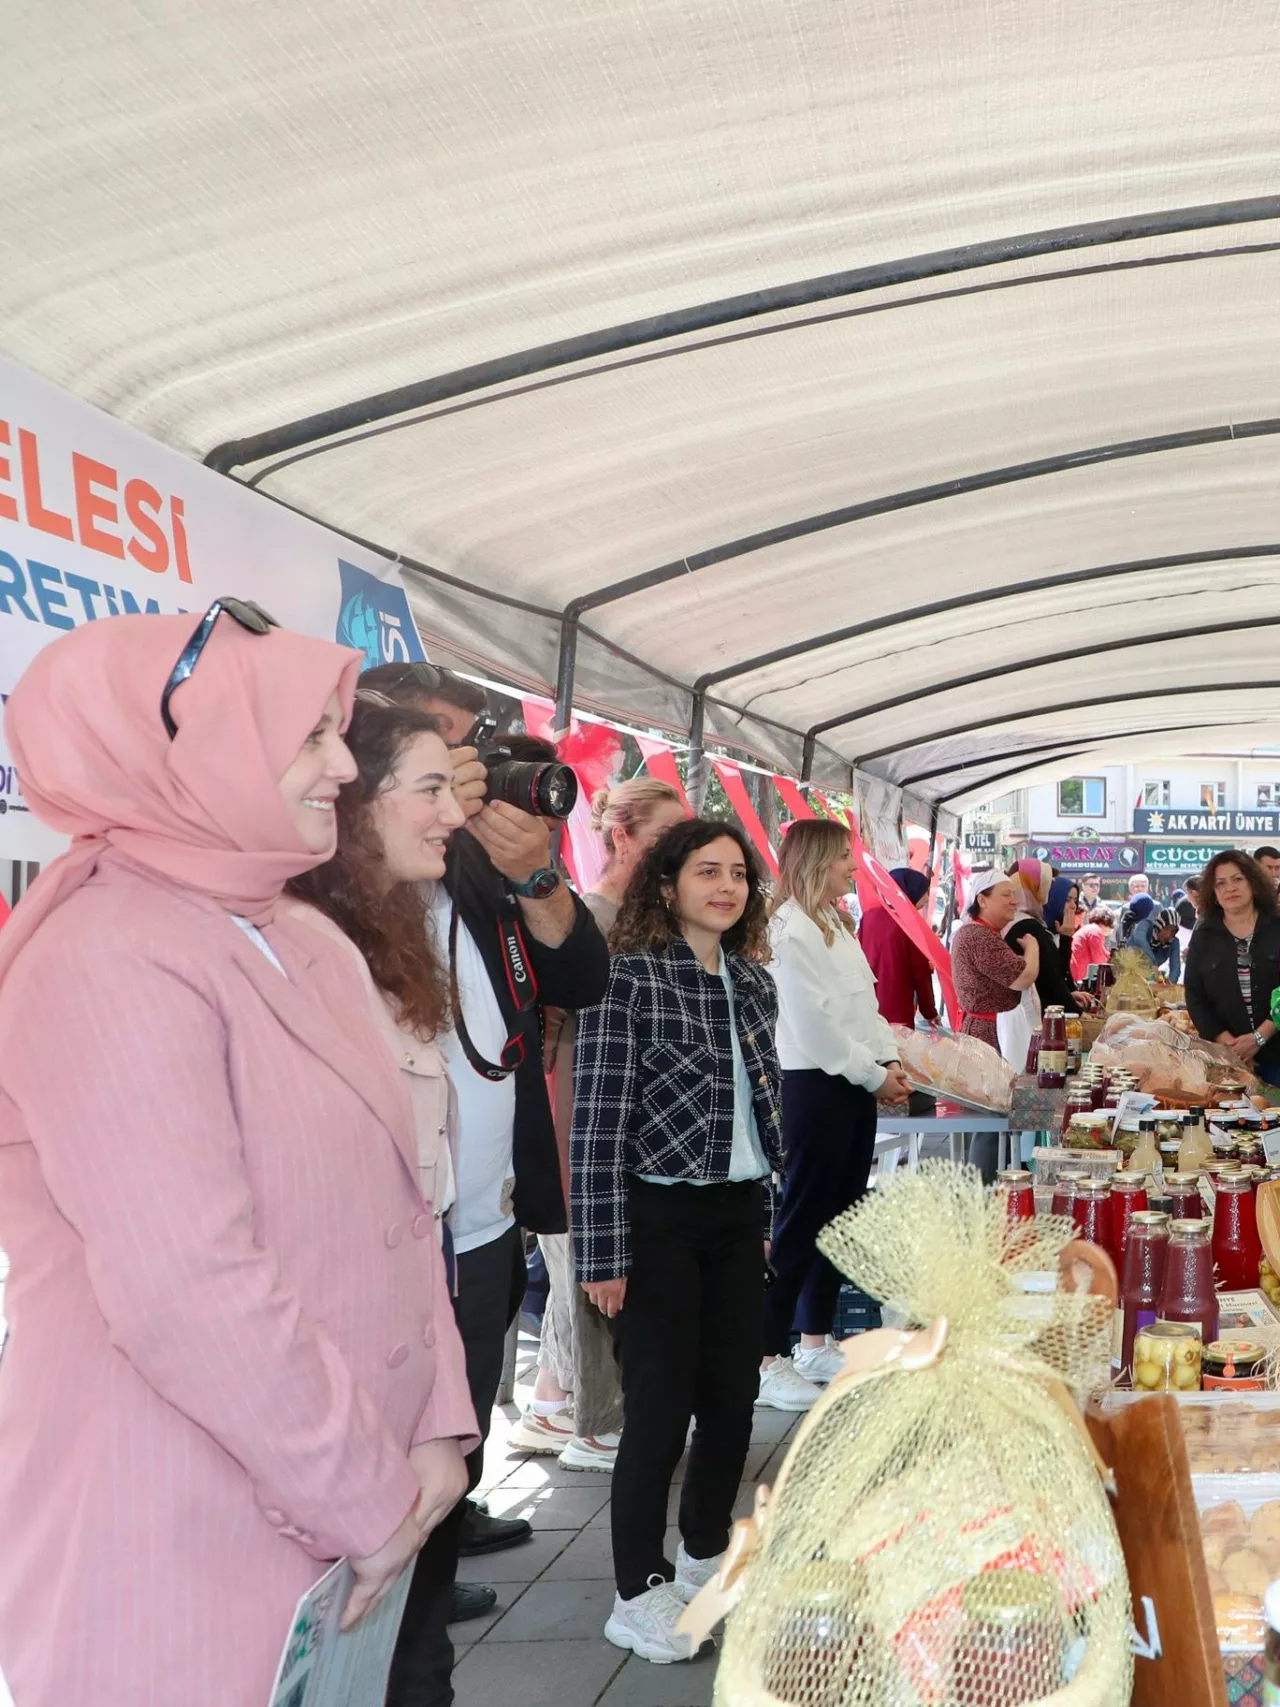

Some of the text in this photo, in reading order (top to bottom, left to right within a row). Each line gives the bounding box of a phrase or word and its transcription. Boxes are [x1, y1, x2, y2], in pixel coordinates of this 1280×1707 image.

[1167, 814, 1188, 830] AK
[1190, 812, 1231, 831] PARTİ
[1235, 812, 1273, 831] ÜNYE
[969, 834, 991, 847] OTEL
[1051, 846, 1118, 861] SARAY
[507, 936, 527, 983] Canon
